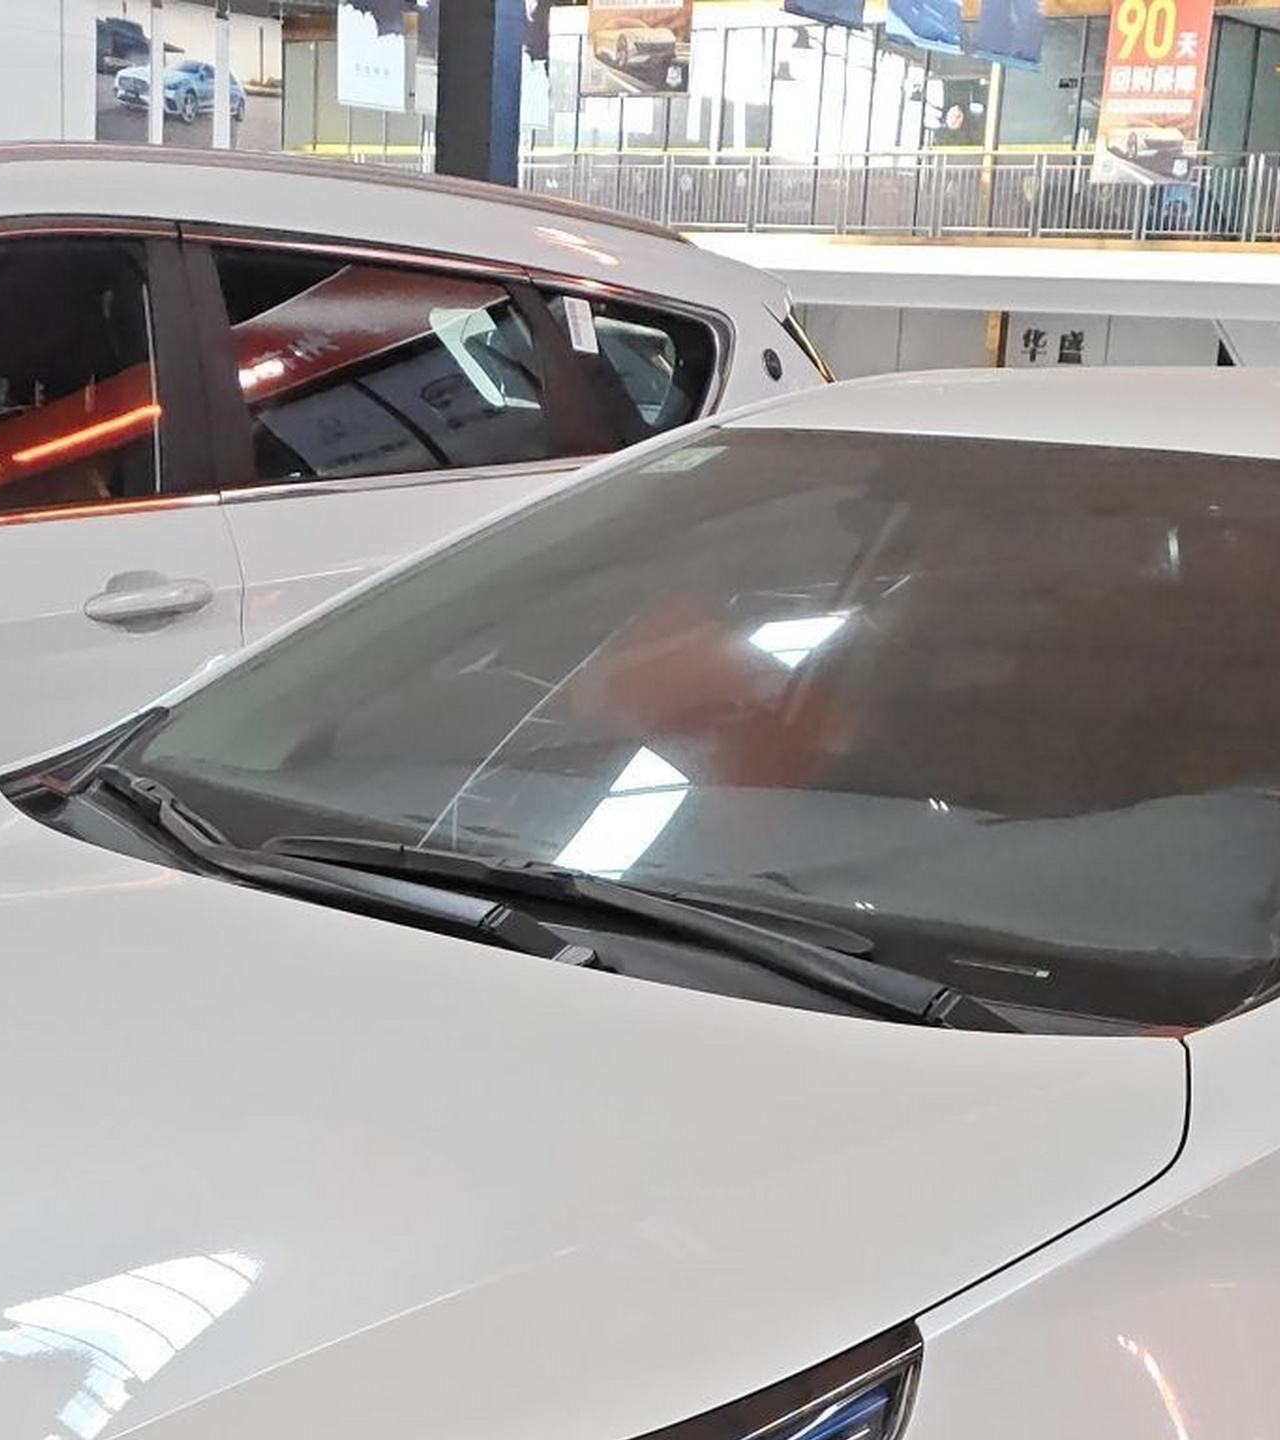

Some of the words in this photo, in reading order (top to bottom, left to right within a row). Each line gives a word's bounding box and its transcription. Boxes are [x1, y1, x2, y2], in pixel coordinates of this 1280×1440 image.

[1109, 65, 1198, 93] 回购保障
[1022, 329, 1084, 364] 华盛
